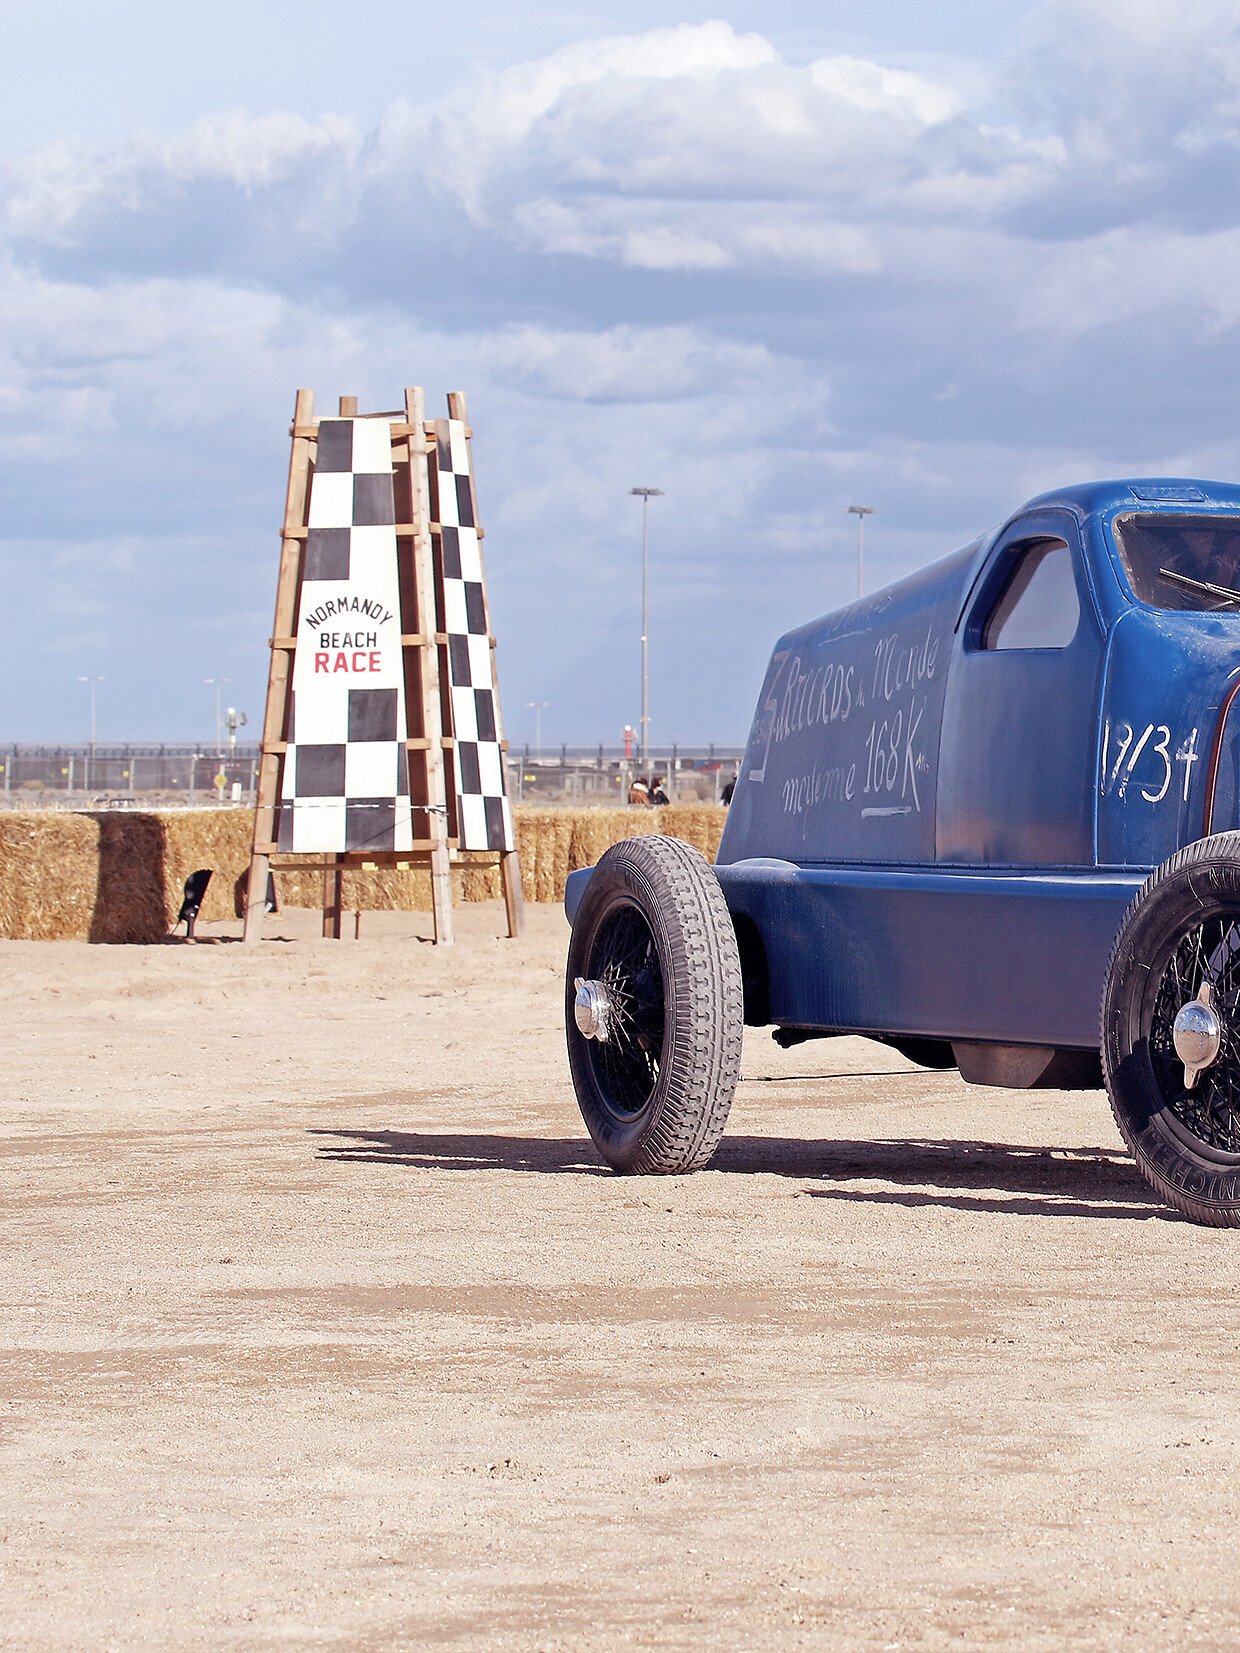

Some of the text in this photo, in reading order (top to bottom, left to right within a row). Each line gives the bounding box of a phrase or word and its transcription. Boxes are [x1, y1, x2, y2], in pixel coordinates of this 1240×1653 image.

[305, 596, 394, 630] NORMANDY
[320, 632, 377, 649] BEACH
[314, 651, 382, 673] RACE
